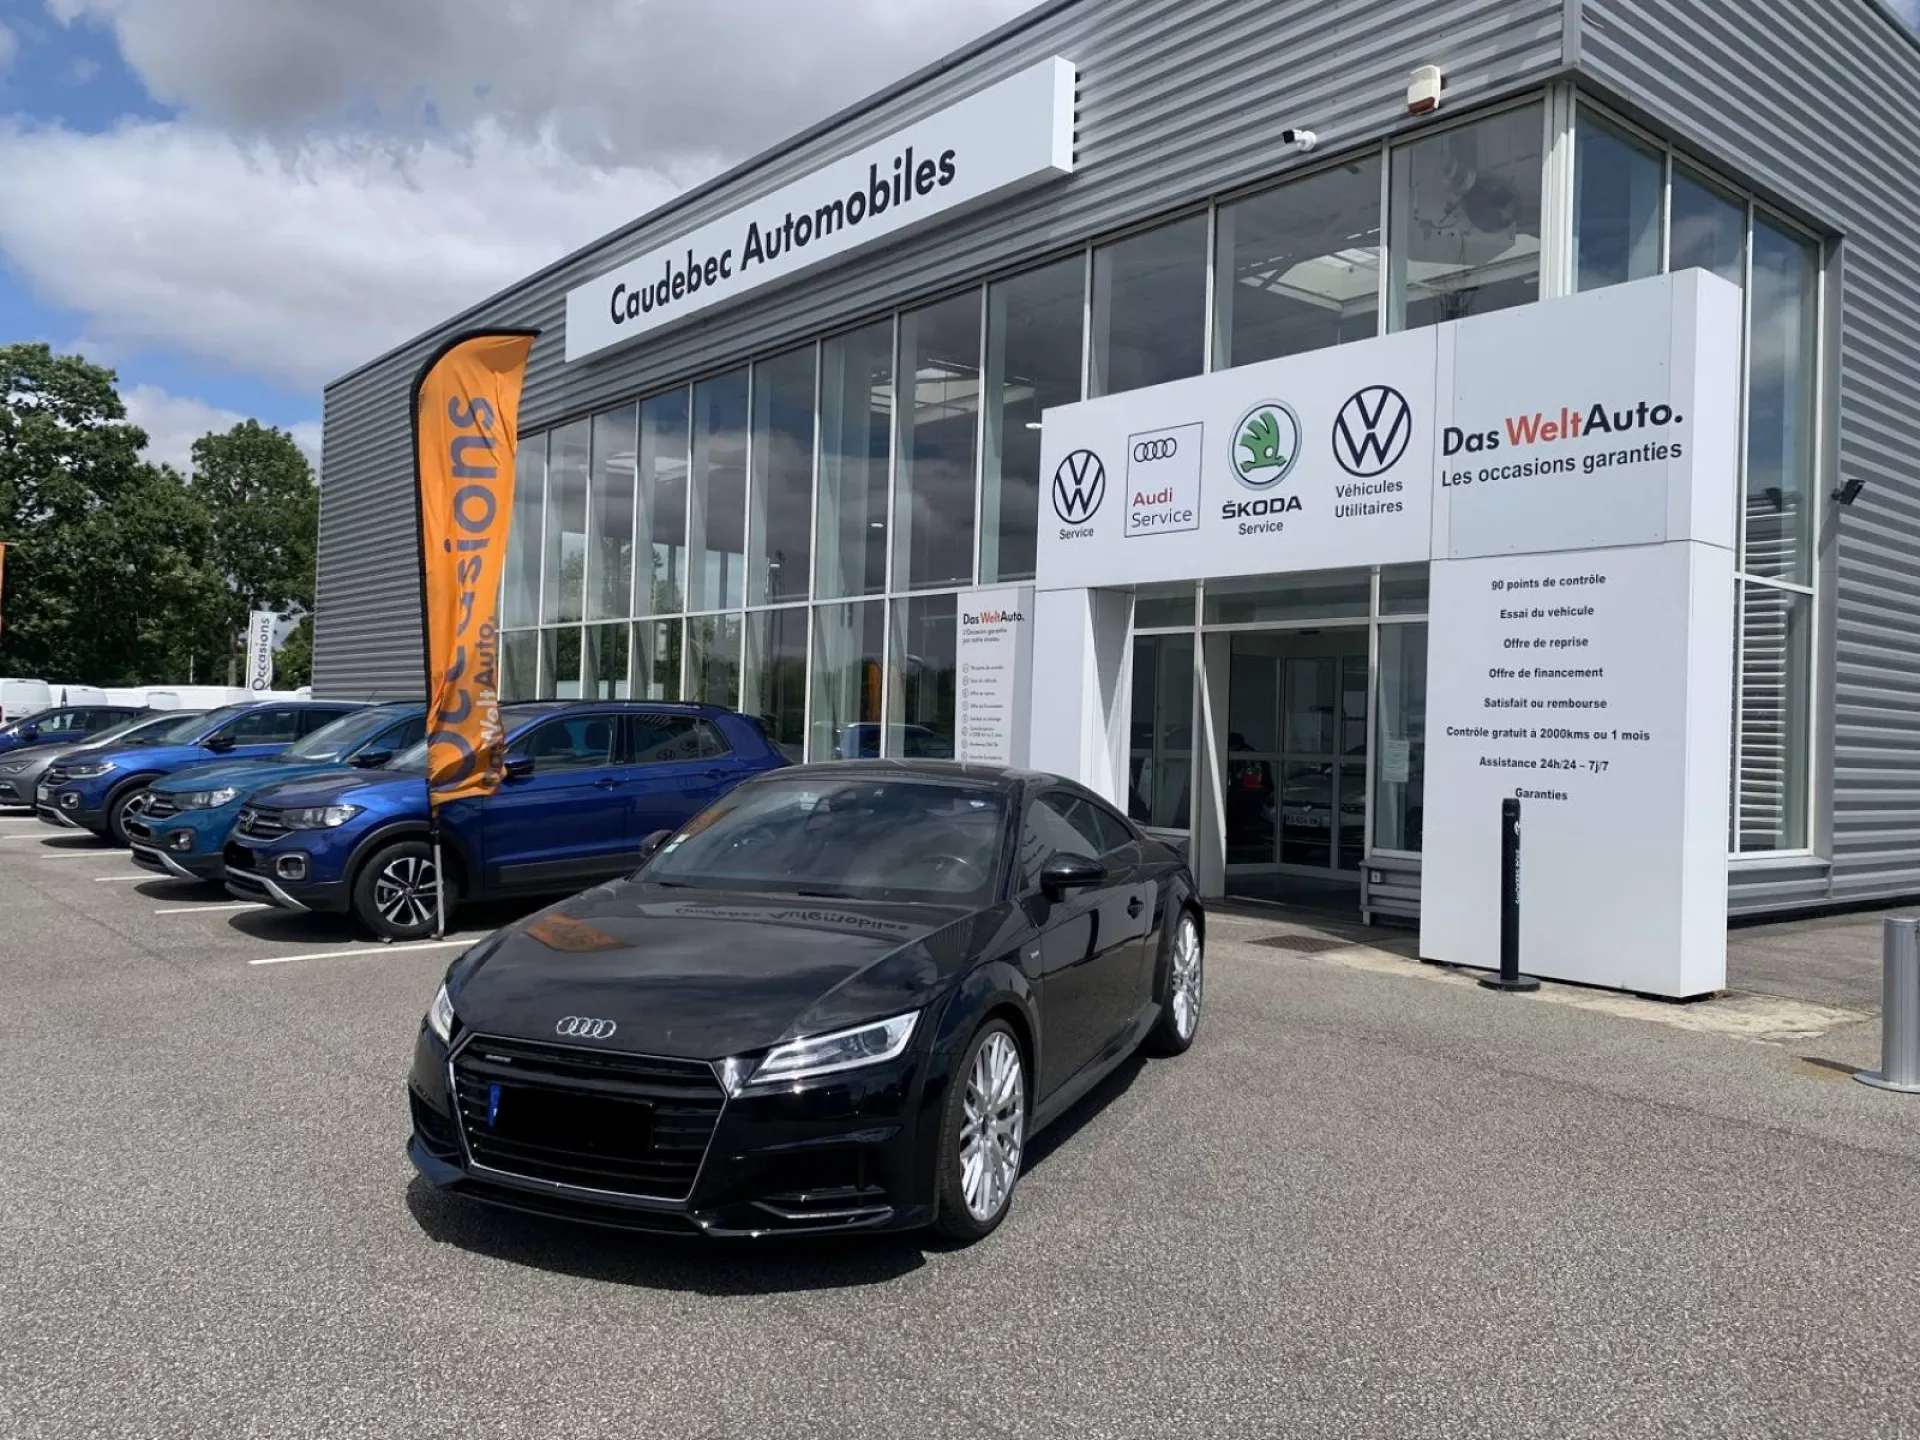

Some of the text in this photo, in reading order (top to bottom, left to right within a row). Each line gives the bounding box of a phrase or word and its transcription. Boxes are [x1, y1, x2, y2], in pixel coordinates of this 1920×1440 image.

[610, 146, 956, 324] Caudebec Automobiles
[1443, 426, 1500, 457] Das
[1441, 441, 1682, 487] Les occasions garanties
[1335, 480, 1404, 498] Véhicules
[1132, 487, 1173, 508] Audi
[1222, 495, 1302, 520] ŠKODA
[1335, 501, 1403, 518] Utilitaires
[1131, 507, 1193, 528] Service
[1059, 526, 1094, 540] Service
[1238, 520, 1284, 535] Service
[1491, 573, 1606, 592] 90 points de contrôle
[963, 613, 979, 625] Das
[1500, 608, 1528, 619] Essai
[1531, 607, 1544, 618] du
[1503, 636, 1589, 649] Offre de reprise
[252, 618, 270, 691] Occasions
[1489, 667, 1603, 678] Offre de financement
[1484, 697, 1528, 708] Satisfait
[1530, 700, 1544, 708] ou
[1446, 726, 1650, 741] Contrôle gratuit à 2000kms ou 1 mois
[1479, 756, 1537, 768] Assistance
[1515, 787, 1568, 800] Garanties
